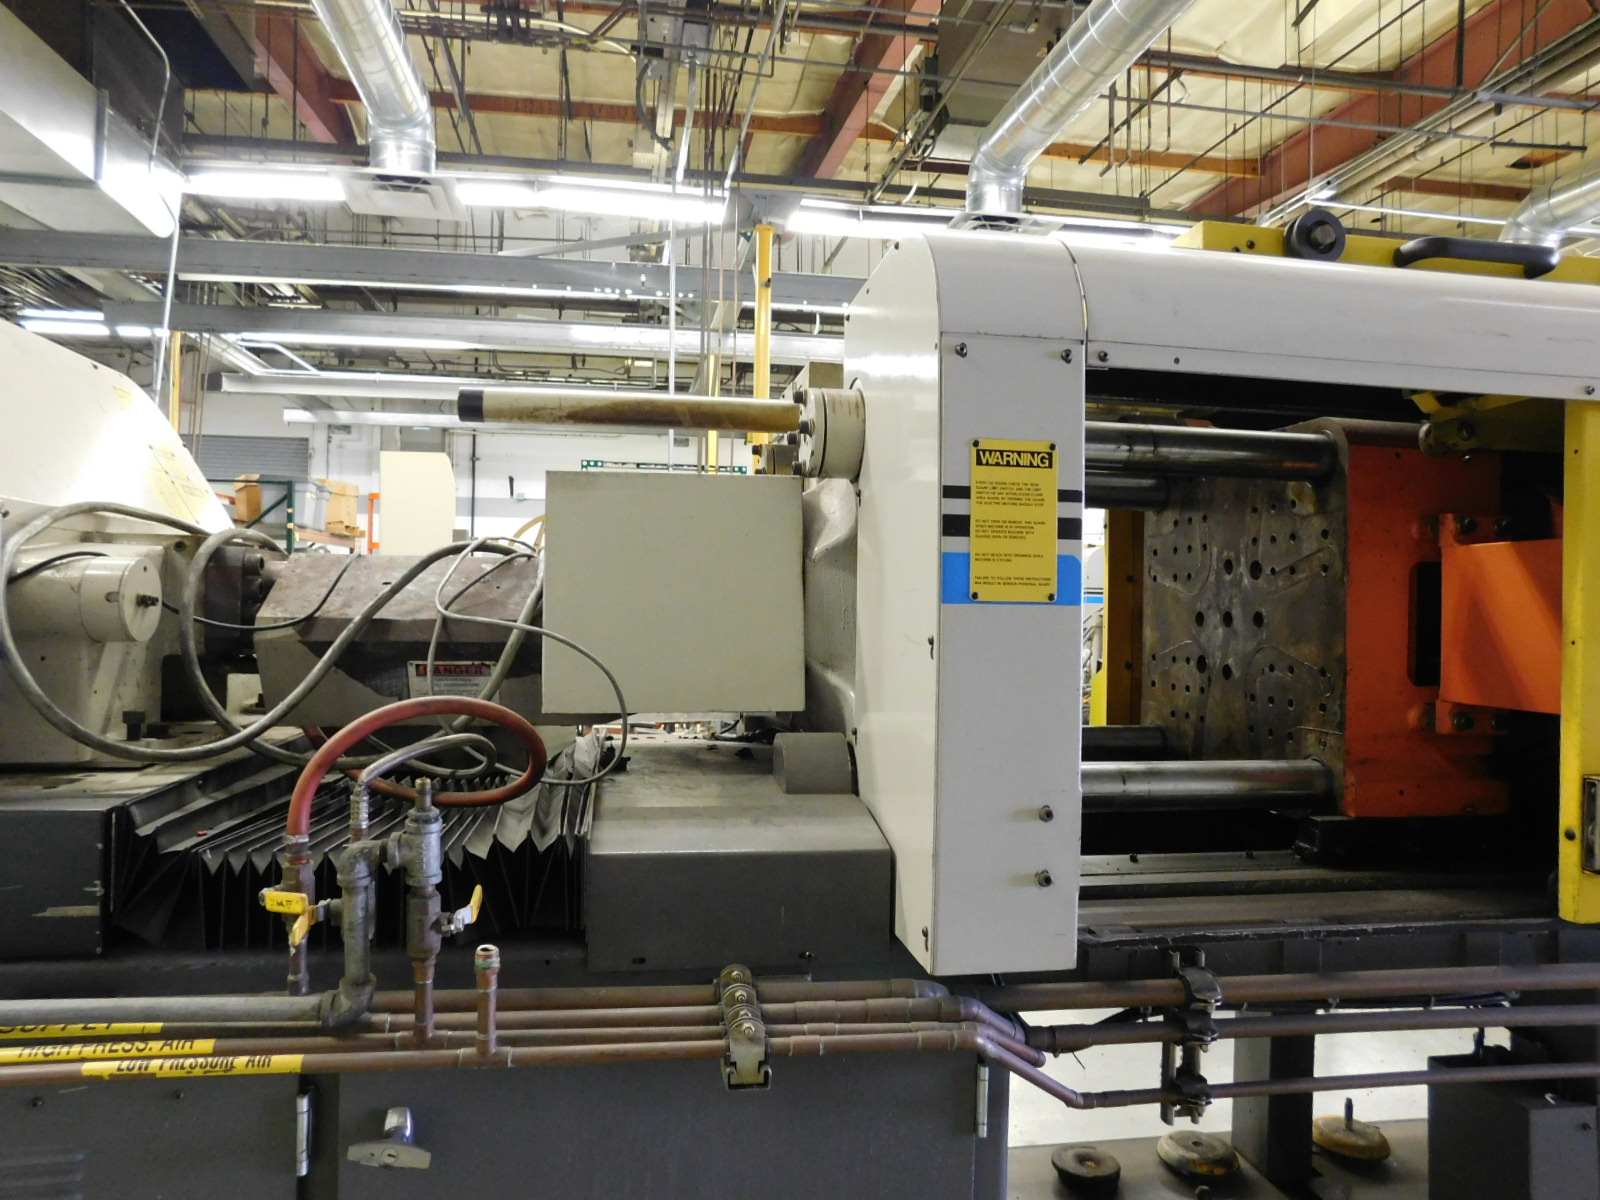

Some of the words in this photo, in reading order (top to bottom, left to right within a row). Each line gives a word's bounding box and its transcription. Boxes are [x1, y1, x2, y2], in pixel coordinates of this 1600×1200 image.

[980, 451, 1049, 467] WARNING
[116, 1058, 151, 1072] LOW
[159, 1056, 239, 1071] PRESSURE
[245, 1055, 272, 1069] AIR
